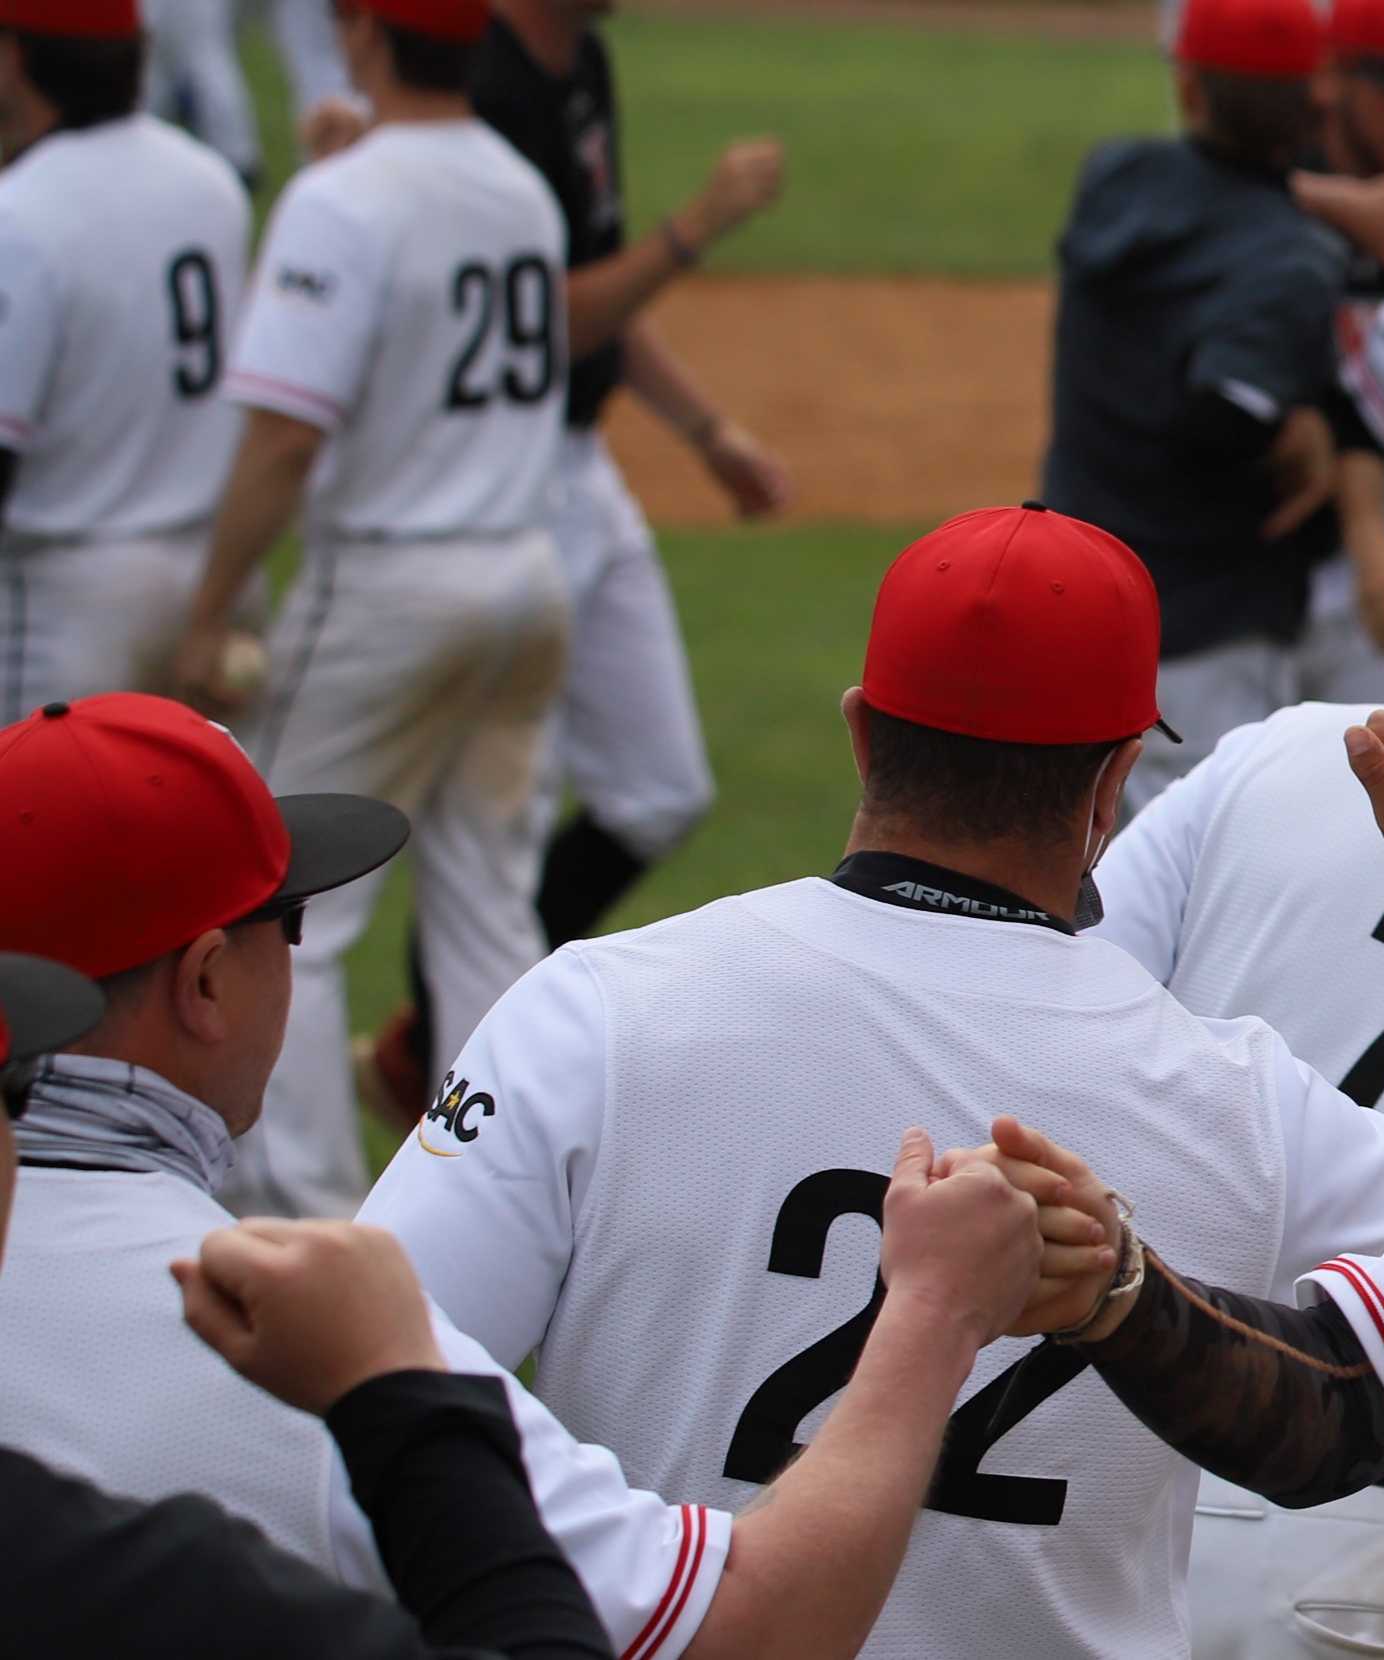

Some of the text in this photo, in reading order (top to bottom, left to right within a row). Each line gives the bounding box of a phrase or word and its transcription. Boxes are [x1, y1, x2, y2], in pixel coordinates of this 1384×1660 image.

[166, 250, 222, 398] 9
[446, 255, 556, 408] 29
[880, 880, 1051, 921] ARMOUR
[427, 1070, 495, 1143] SAC
